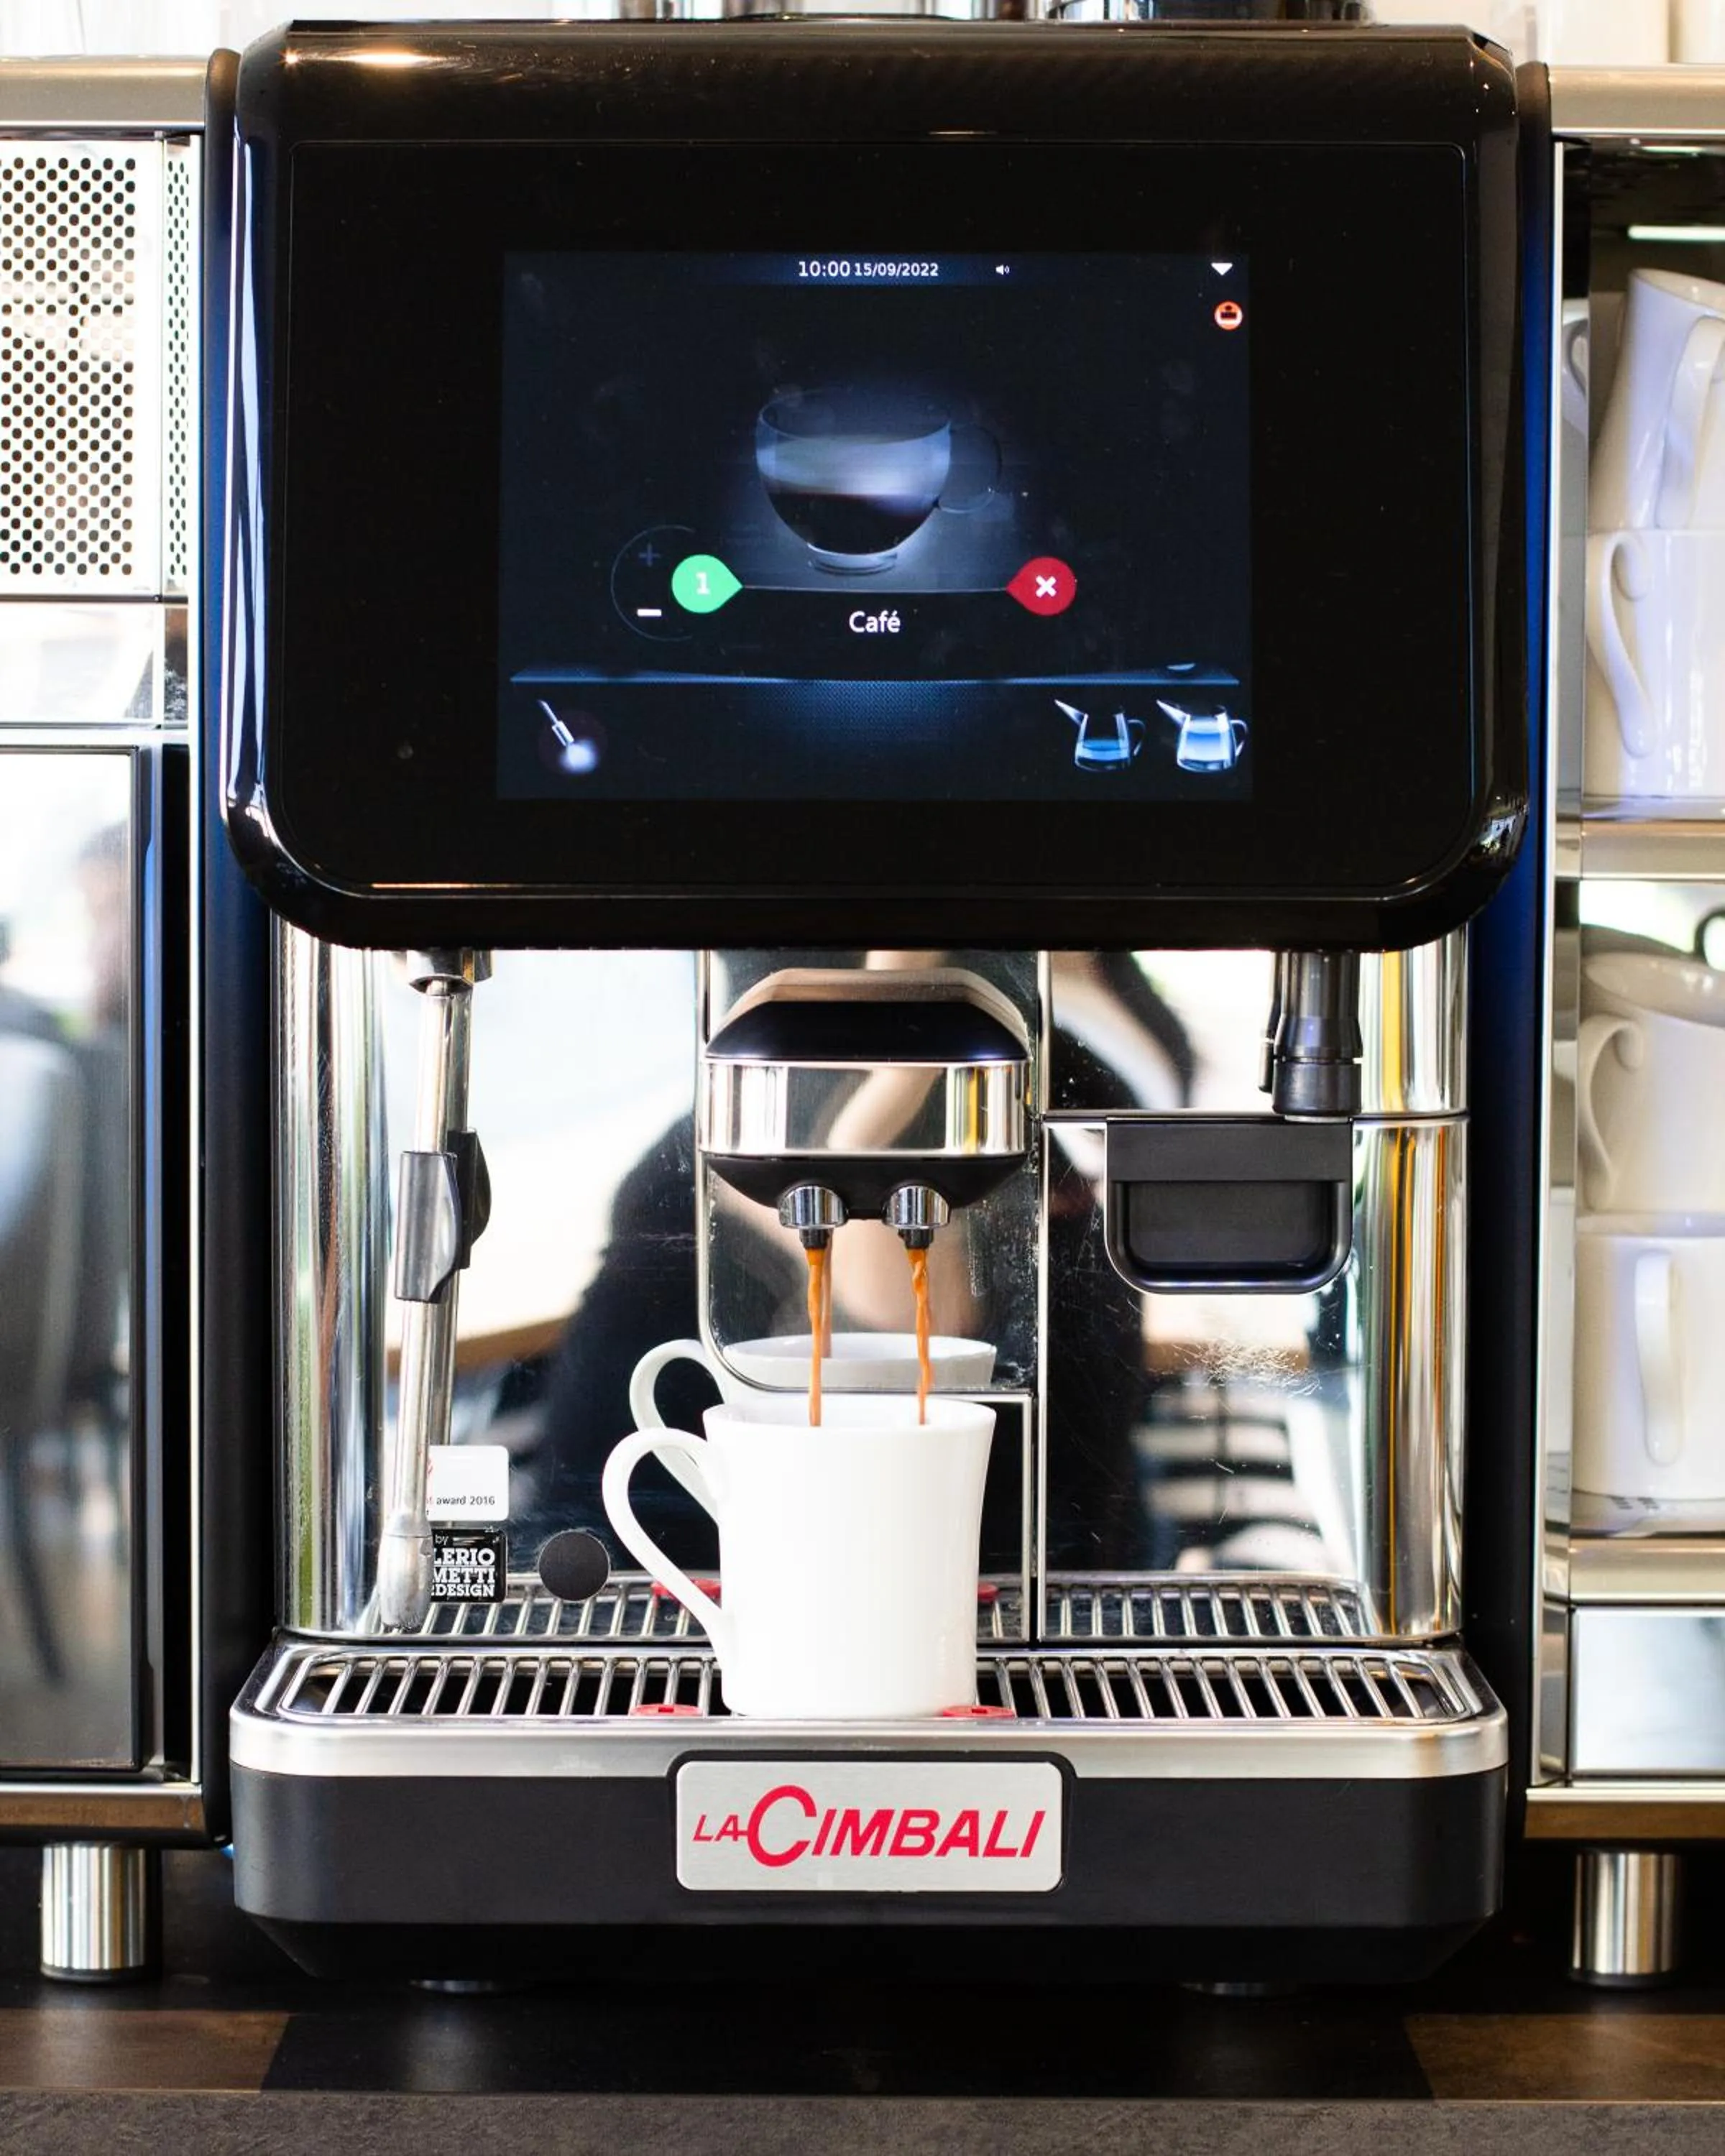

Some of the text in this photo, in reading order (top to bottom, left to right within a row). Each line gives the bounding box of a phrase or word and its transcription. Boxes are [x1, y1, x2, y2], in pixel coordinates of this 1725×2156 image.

[799, 260, 939, 277] 10:00 15/09/2022
[696, 572, 710, 595] 1
[849, 610, 901, 633] Café
[436, 1495, 466, 1506] award
[469, 1495, 495, 1506] 2016
[435, 1534, 448, 1546] by
[433, 1547, 495, 1565] LERIO
[433, 1567, 494, 1583] METTI
[432, 1583, 494, 1597] DESIGN
[747, 1784, 1046, 1868] CIMBALI
